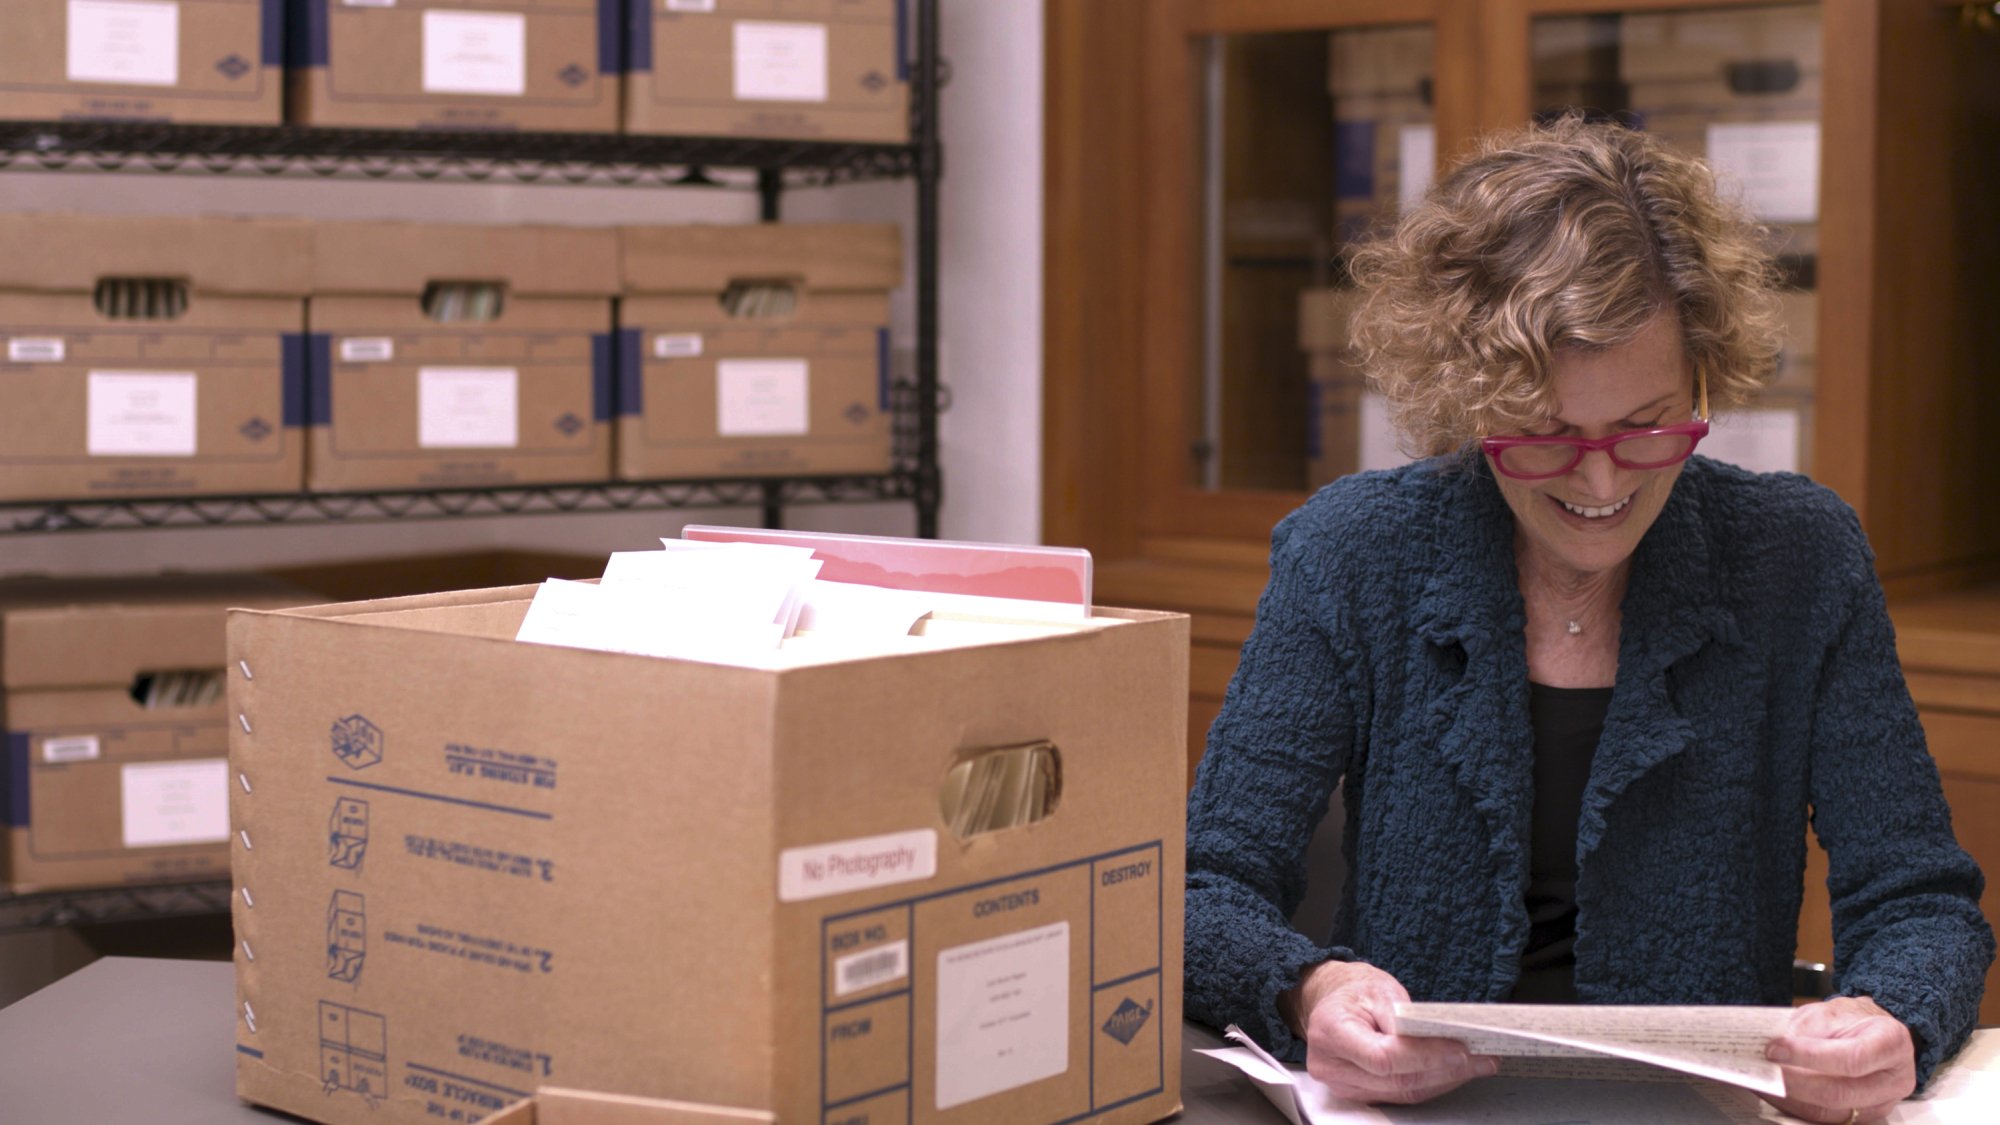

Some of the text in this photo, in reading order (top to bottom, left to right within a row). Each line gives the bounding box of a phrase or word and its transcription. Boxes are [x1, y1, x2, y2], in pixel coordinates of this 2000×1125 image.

[802, 846, 915, 882] No Photography
[1102, 860, 1152, 887] DESTROY
[973, 888, 1040, 918] CONTENTS
[832, 930, 860, 950] BOX
[534, 950, 553, 973] 2.
[831, 1017, 871, 1041] FROM
[535, 1053, 553, 1077] 1.
[442, 1082, 503, 1109] MIRACLE
